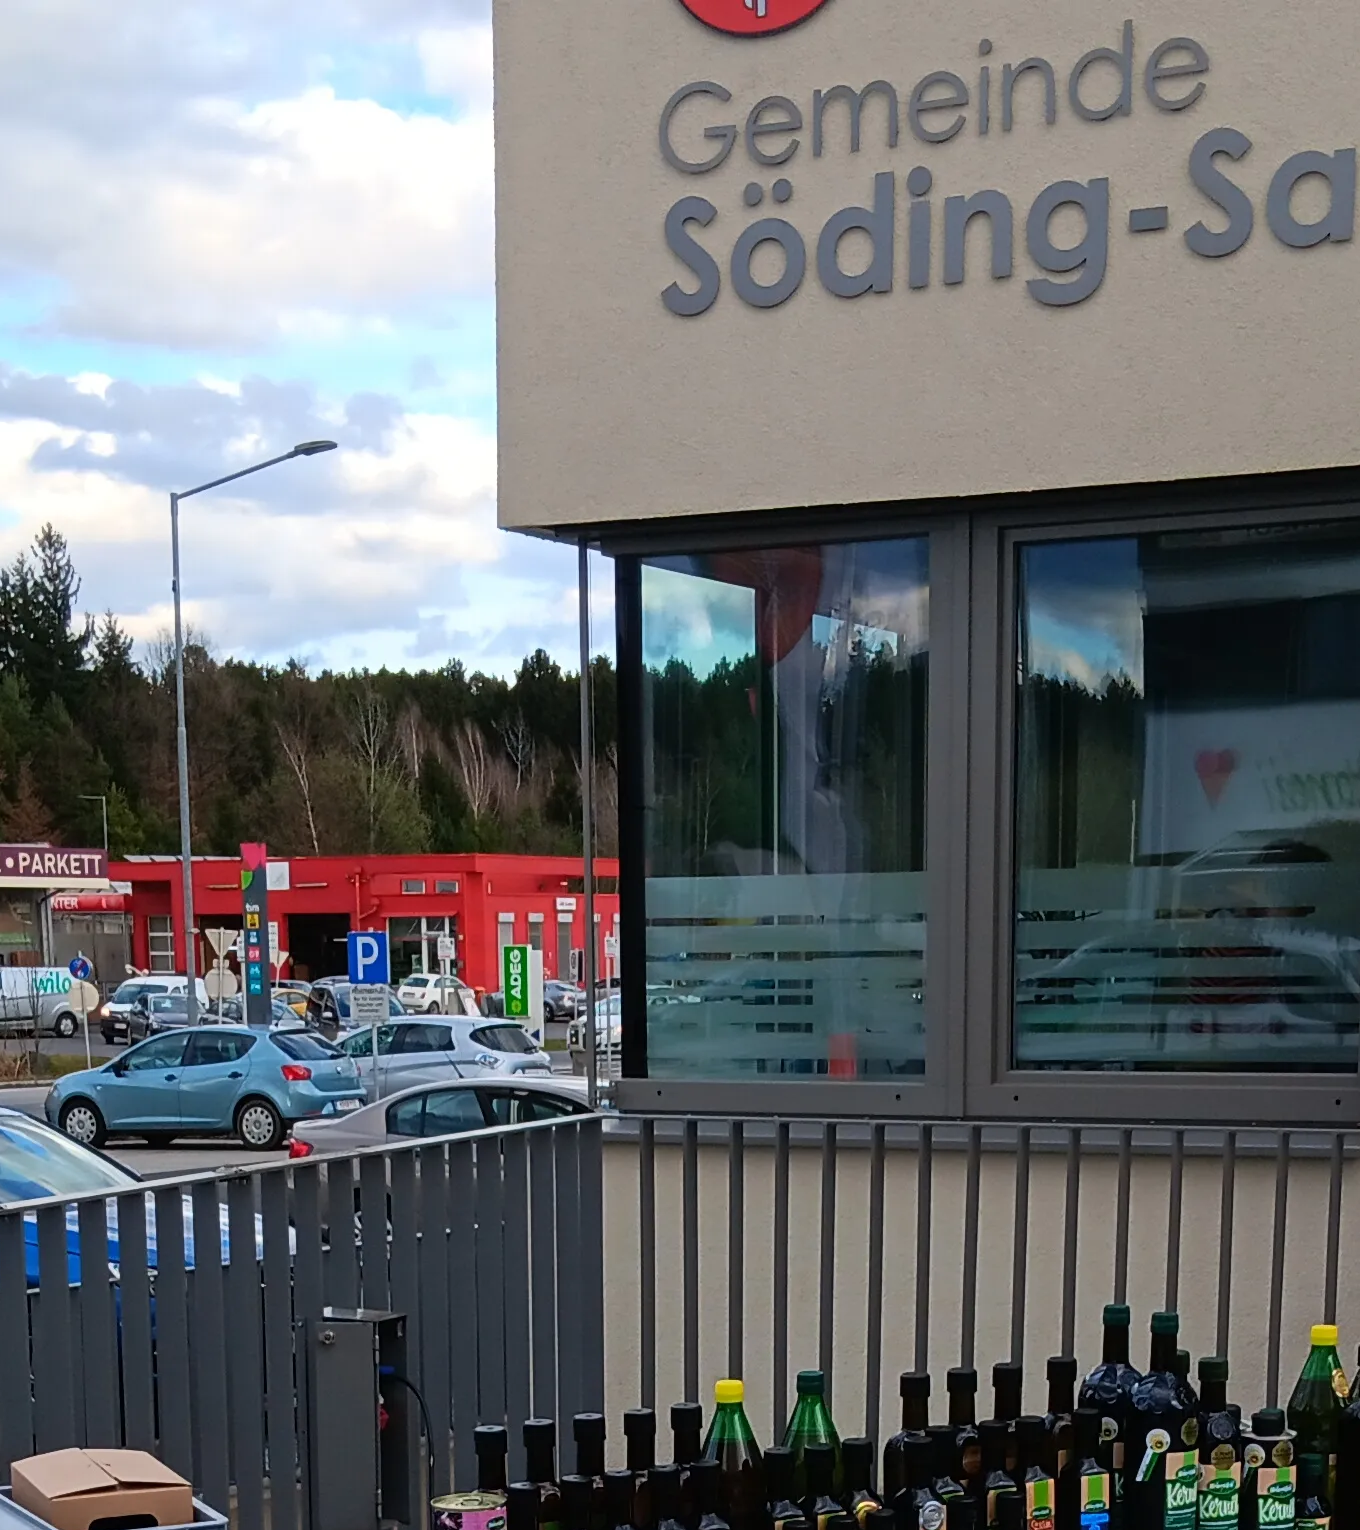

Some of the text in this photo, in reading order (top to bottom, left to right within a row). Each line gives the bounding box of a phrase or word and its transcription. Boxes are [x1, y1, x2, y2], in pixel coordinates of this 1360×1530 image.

[657, 20, 1210, 178] Gemeinde
[18, 852, 102, 876] PARKETT
[355, 936, 379, 981] P
[508, 948, 523, 1000] ADEG
[31, 970, 73, 995] wilo
